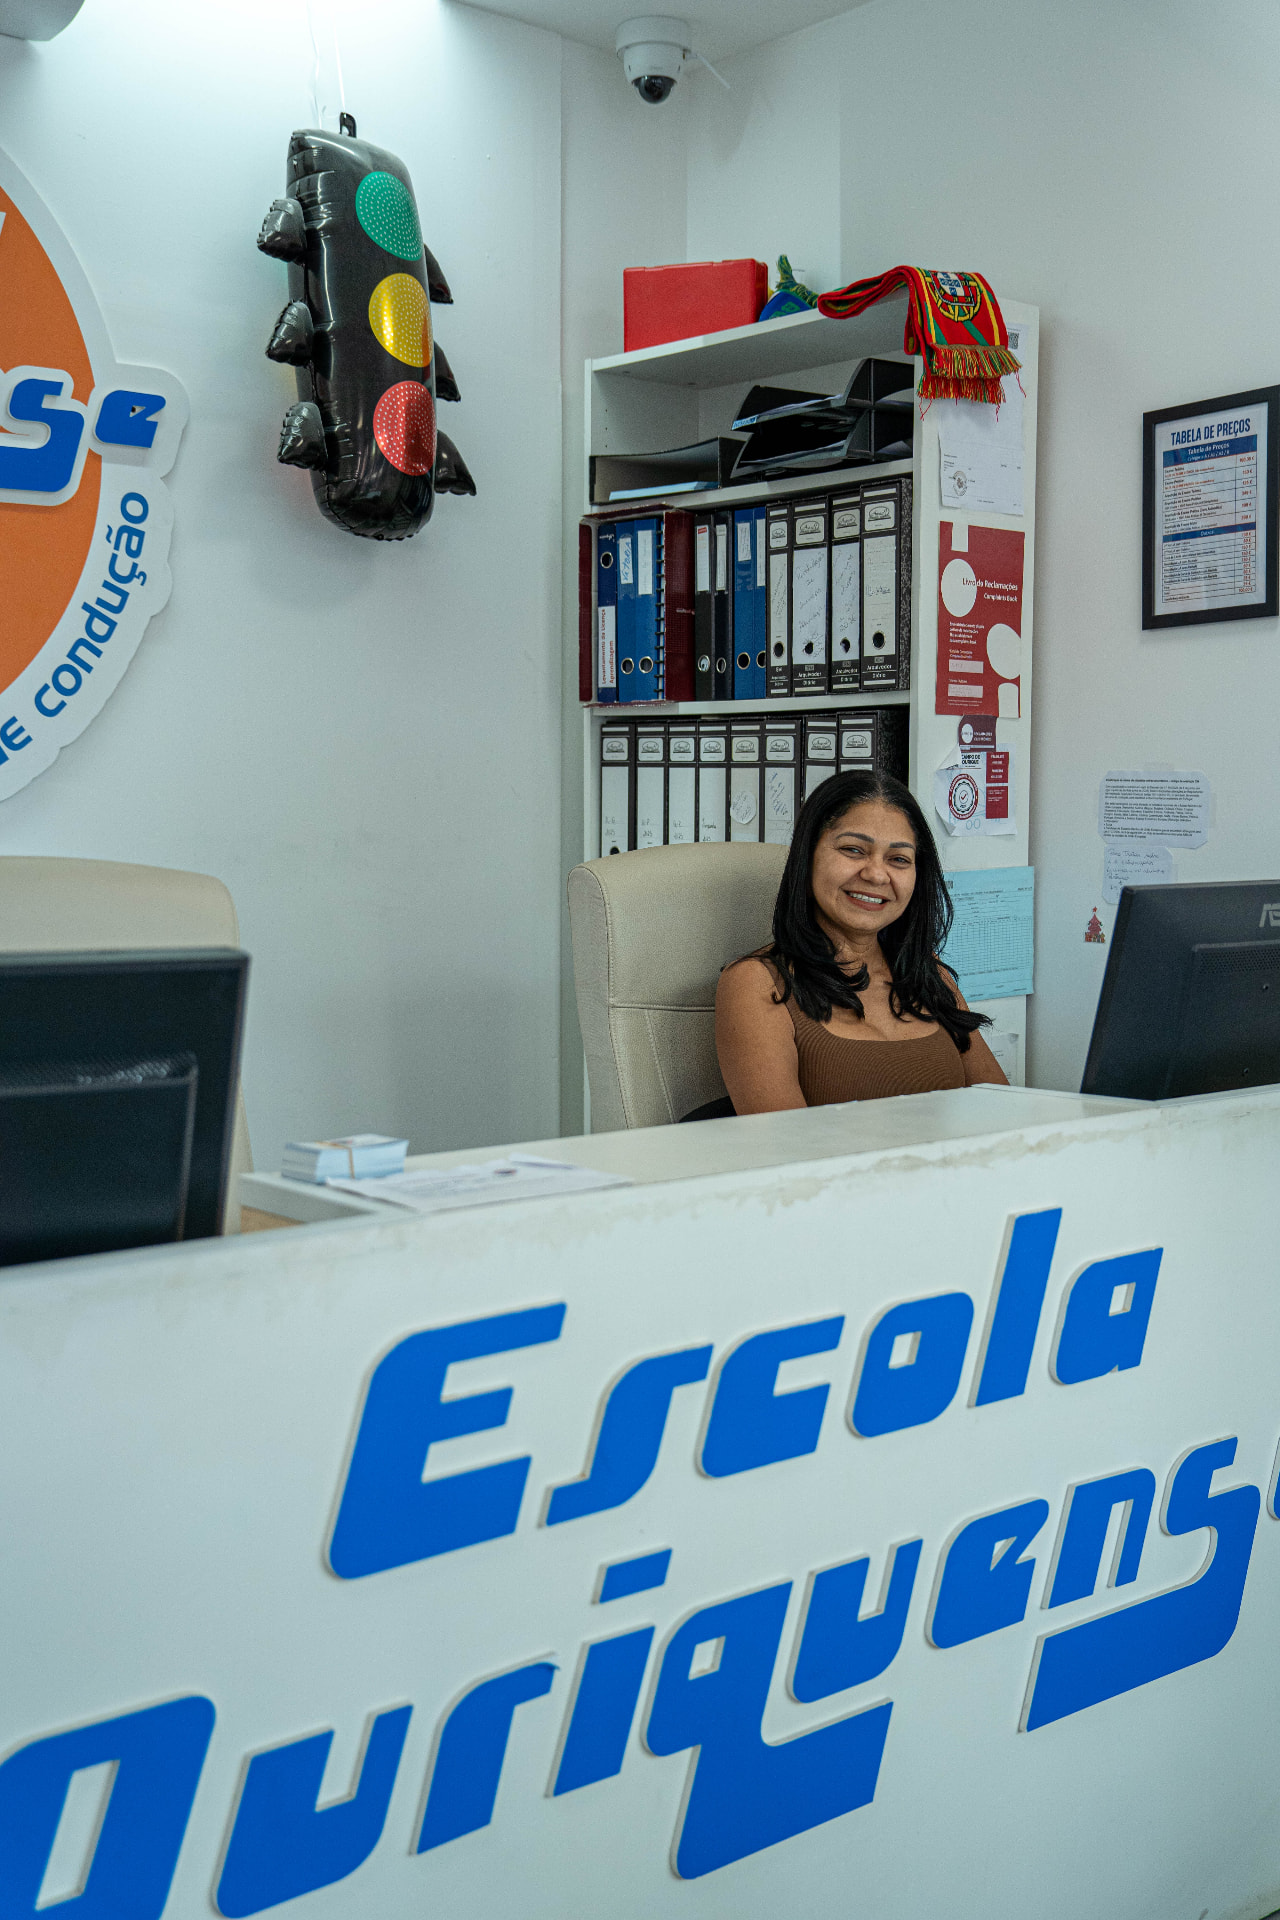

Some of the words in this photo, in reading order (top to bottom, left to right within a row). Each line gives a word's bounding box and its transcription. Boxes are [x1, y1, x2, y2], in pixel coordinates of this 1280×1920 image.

[1171, 427, 1202, 446] TABELA
[1204, 425, 1215, 440] DE
[1217, 418, 1251, 437] PREÇOS
[33, 492, 149, 718] condução
[962, 577, 976, 586] Livro
[984, 580, 1018, 591] Reclamações
[324, 1206, 1164, 1580] Escola
[0, 1435, 1280, 1920] Ouriquens
